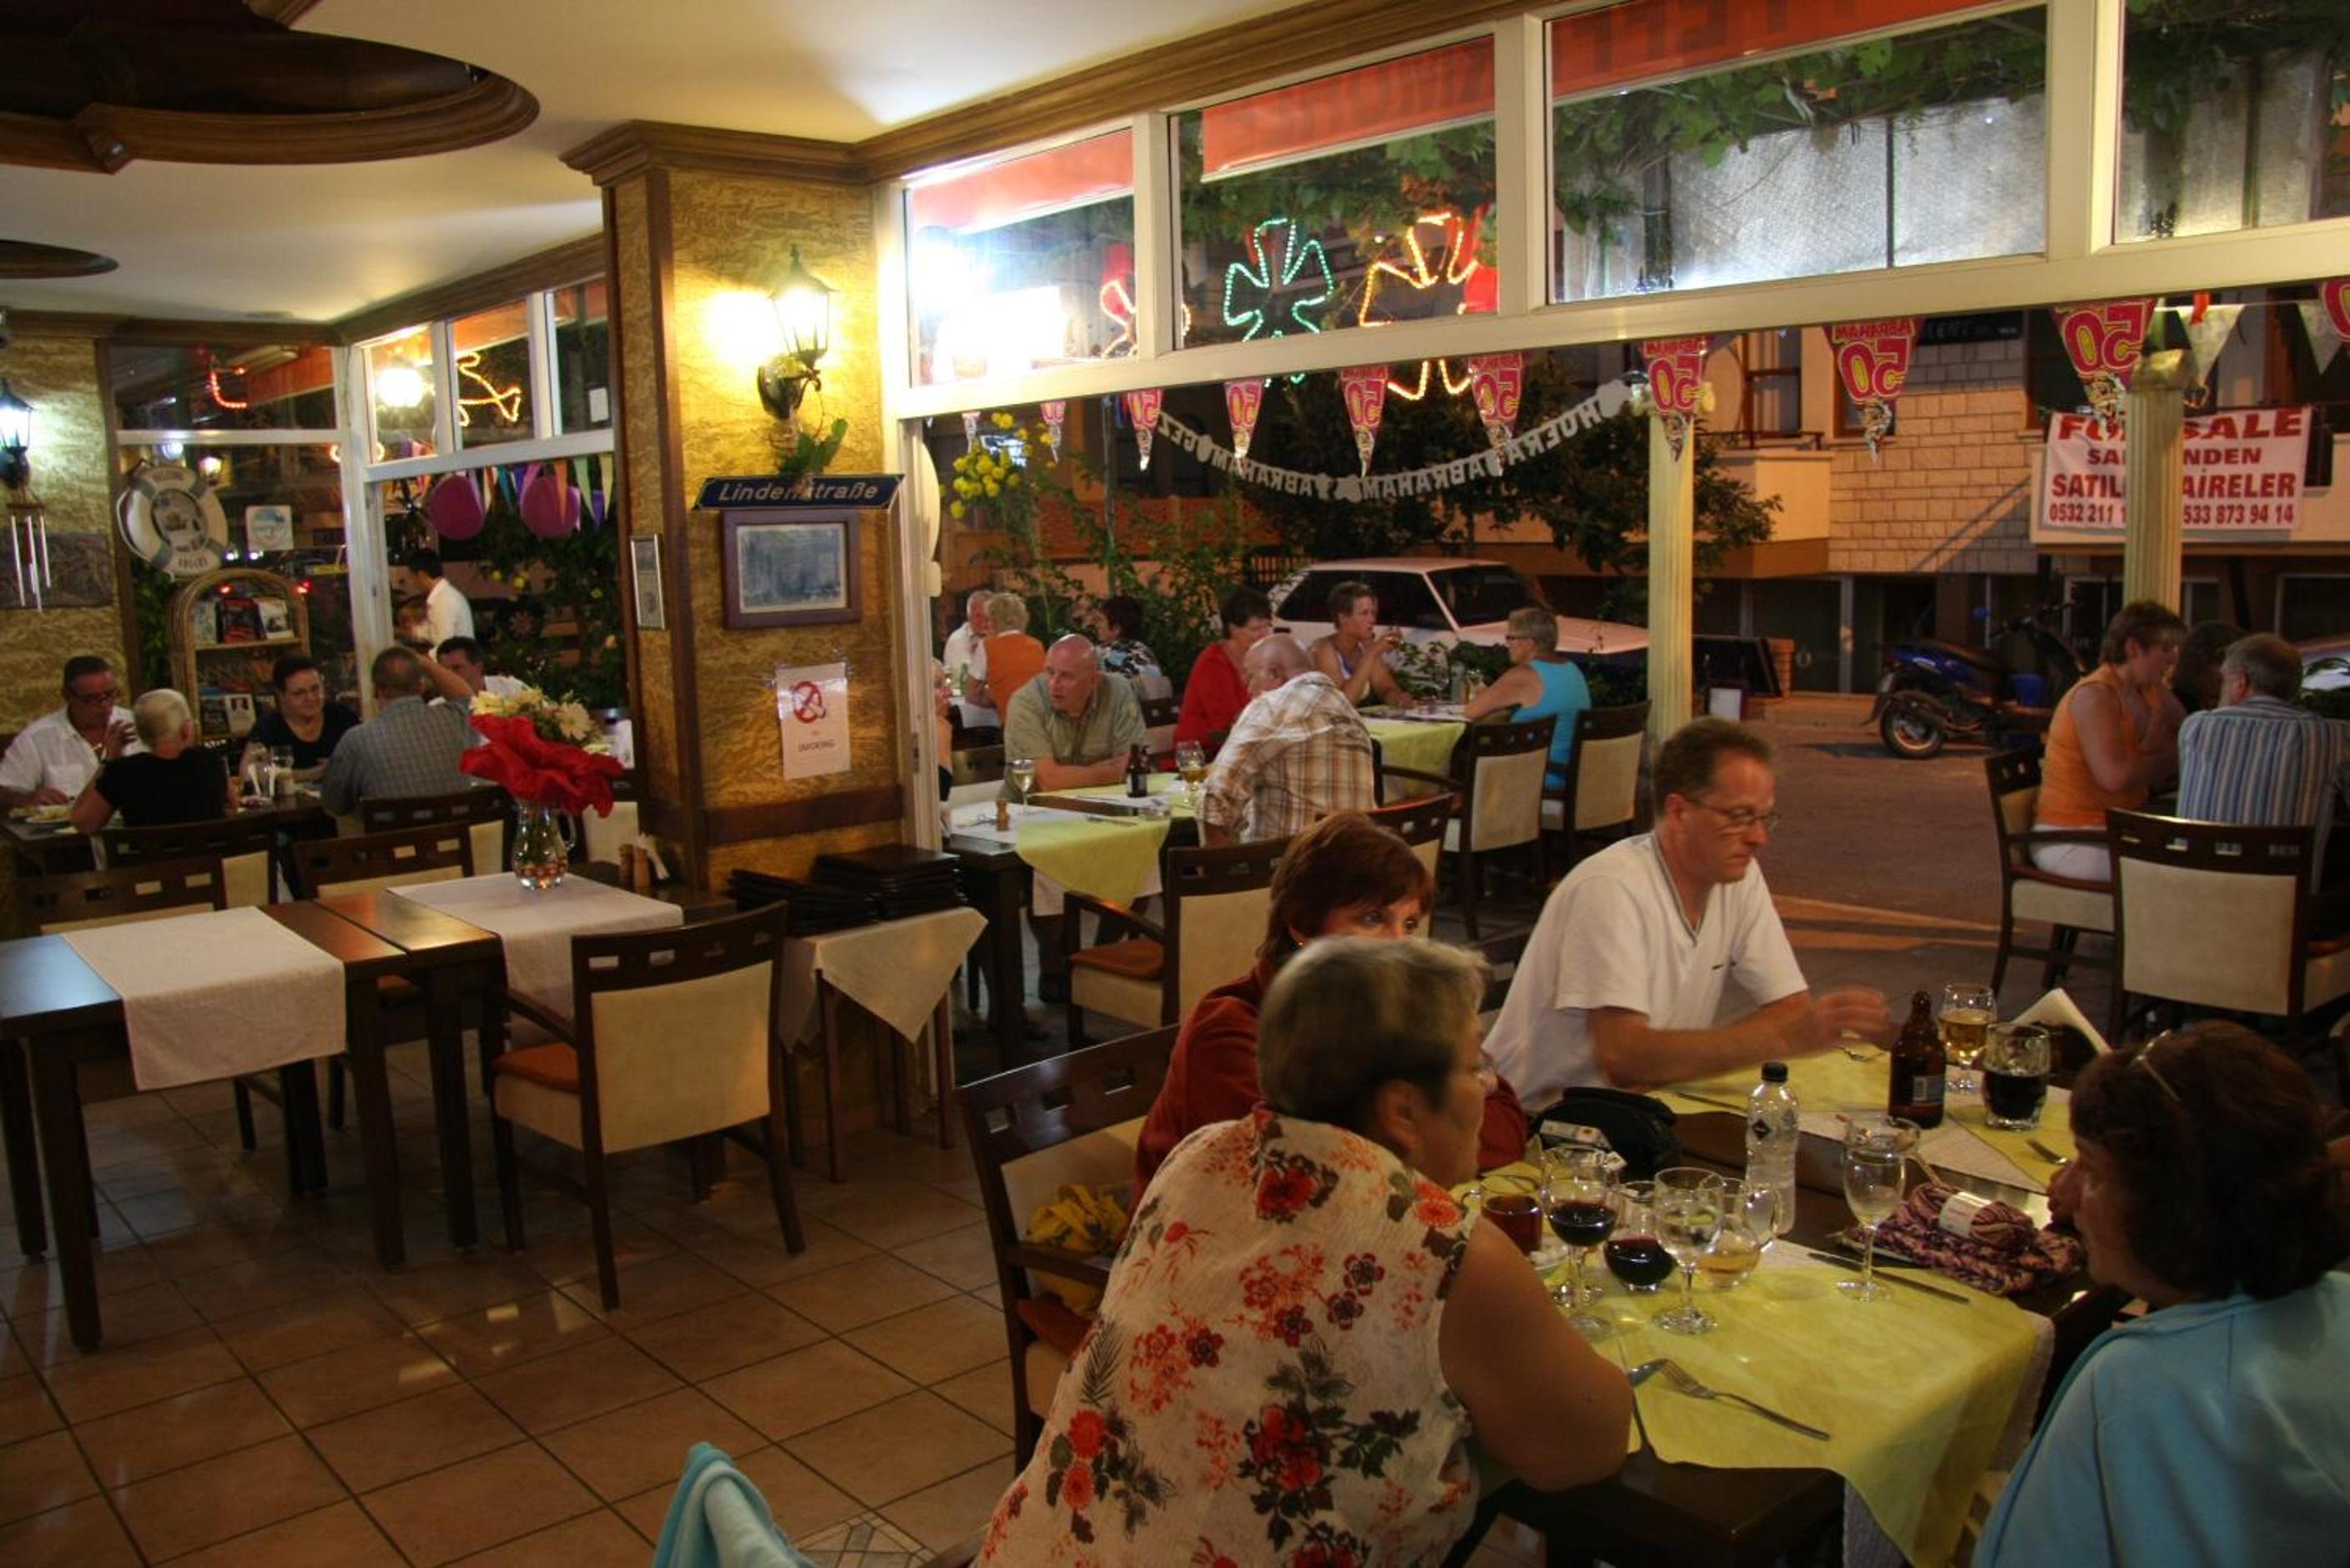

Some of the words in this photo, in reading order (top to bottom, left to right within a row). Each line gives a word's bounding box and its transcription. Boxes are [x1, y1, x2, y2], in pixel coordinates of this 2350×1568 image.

[2059, 414, 2126, 441] FO
[2182, 408, 2302, 439] SALE
[719, 481, 878, 502] Lindentraße
[2052, 474, 2126, 498] SATIL
[2182, 468, 2296, 498] AİRELER
[2050, 503, 2083, 522] 0532
[2088, 504, 2113, 523] 211
[2183, 504, 2210, 524] 533
[2216, 504, 2244, 524] 873
[2251, 504, 2268, 524] 94
[2276, 503, 2294, 524] 14
